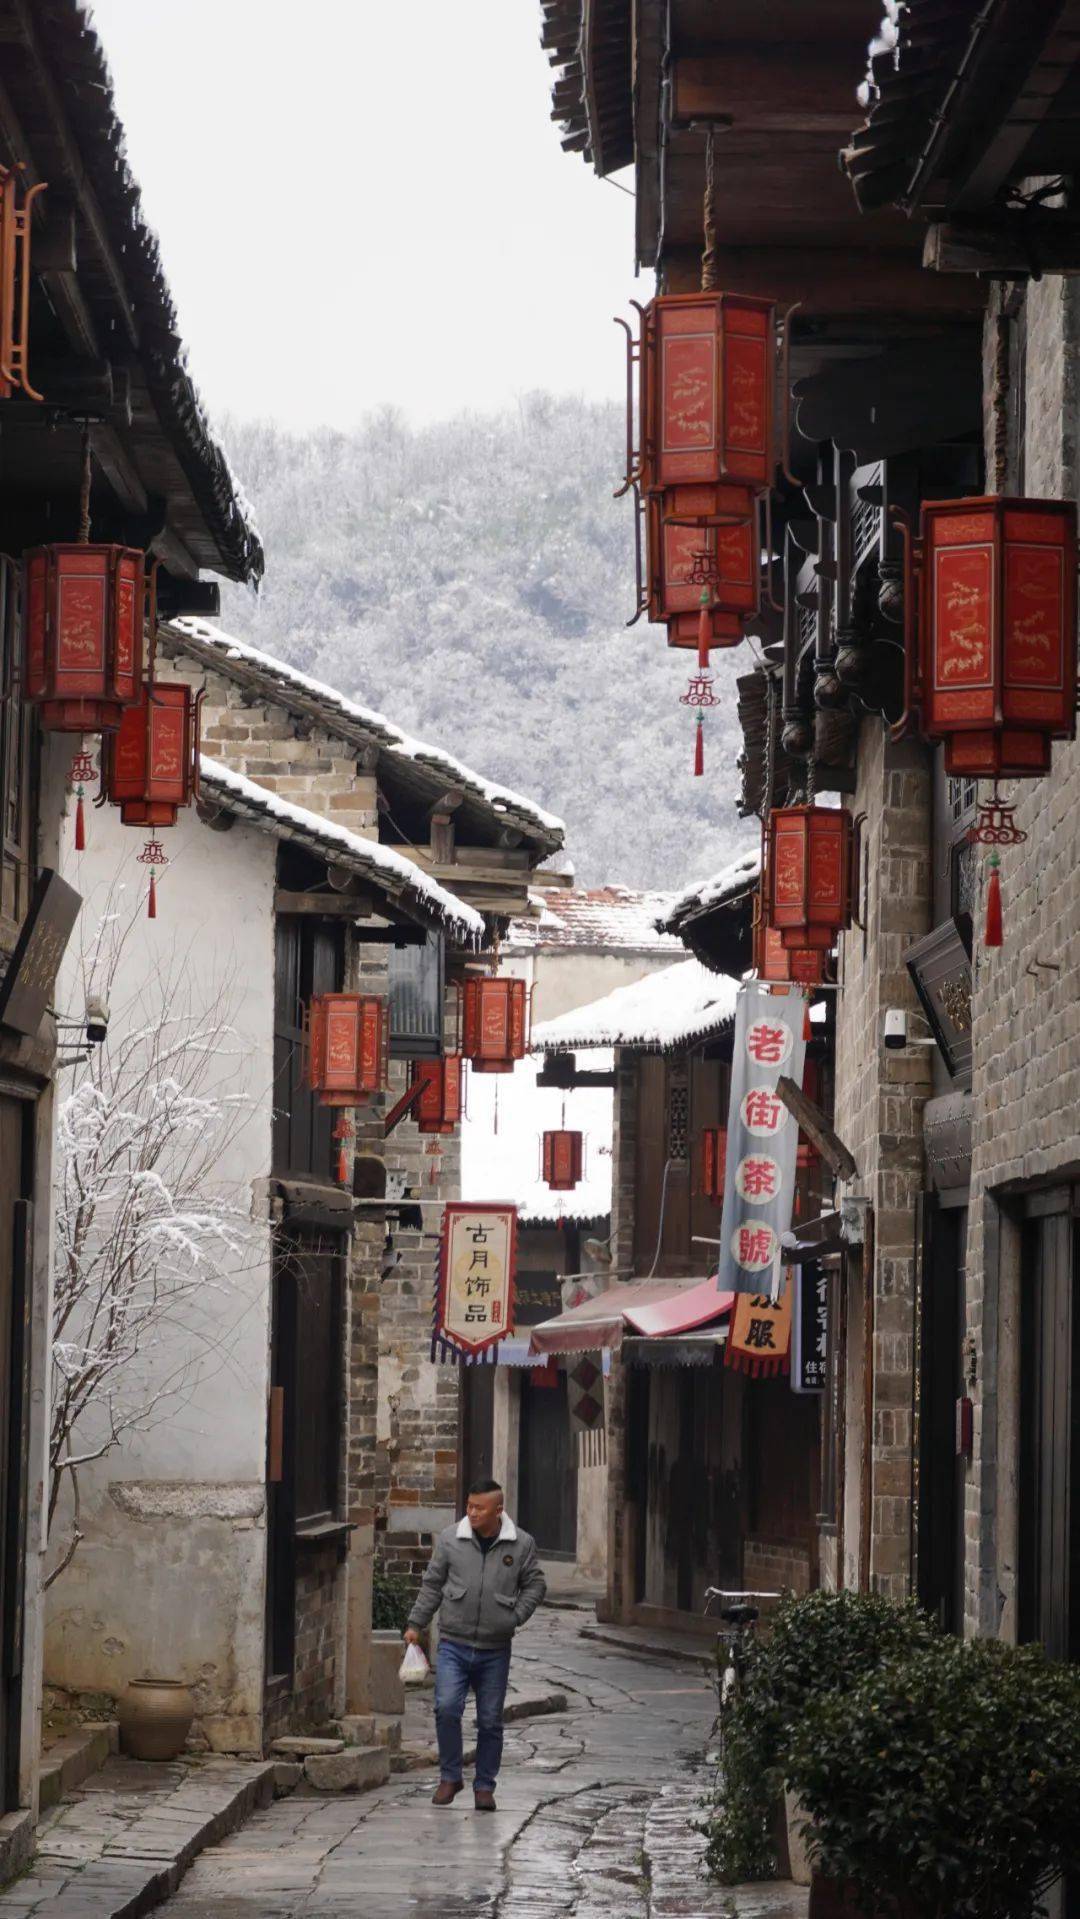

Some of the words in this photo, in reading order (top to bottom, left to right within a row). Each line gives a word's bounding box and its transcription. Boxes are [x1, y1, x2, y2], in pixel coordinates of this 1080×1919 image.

[738, 1024, 785, 1264] 老街茶號
[464, 1223, 495, 1323] 古月饰品
